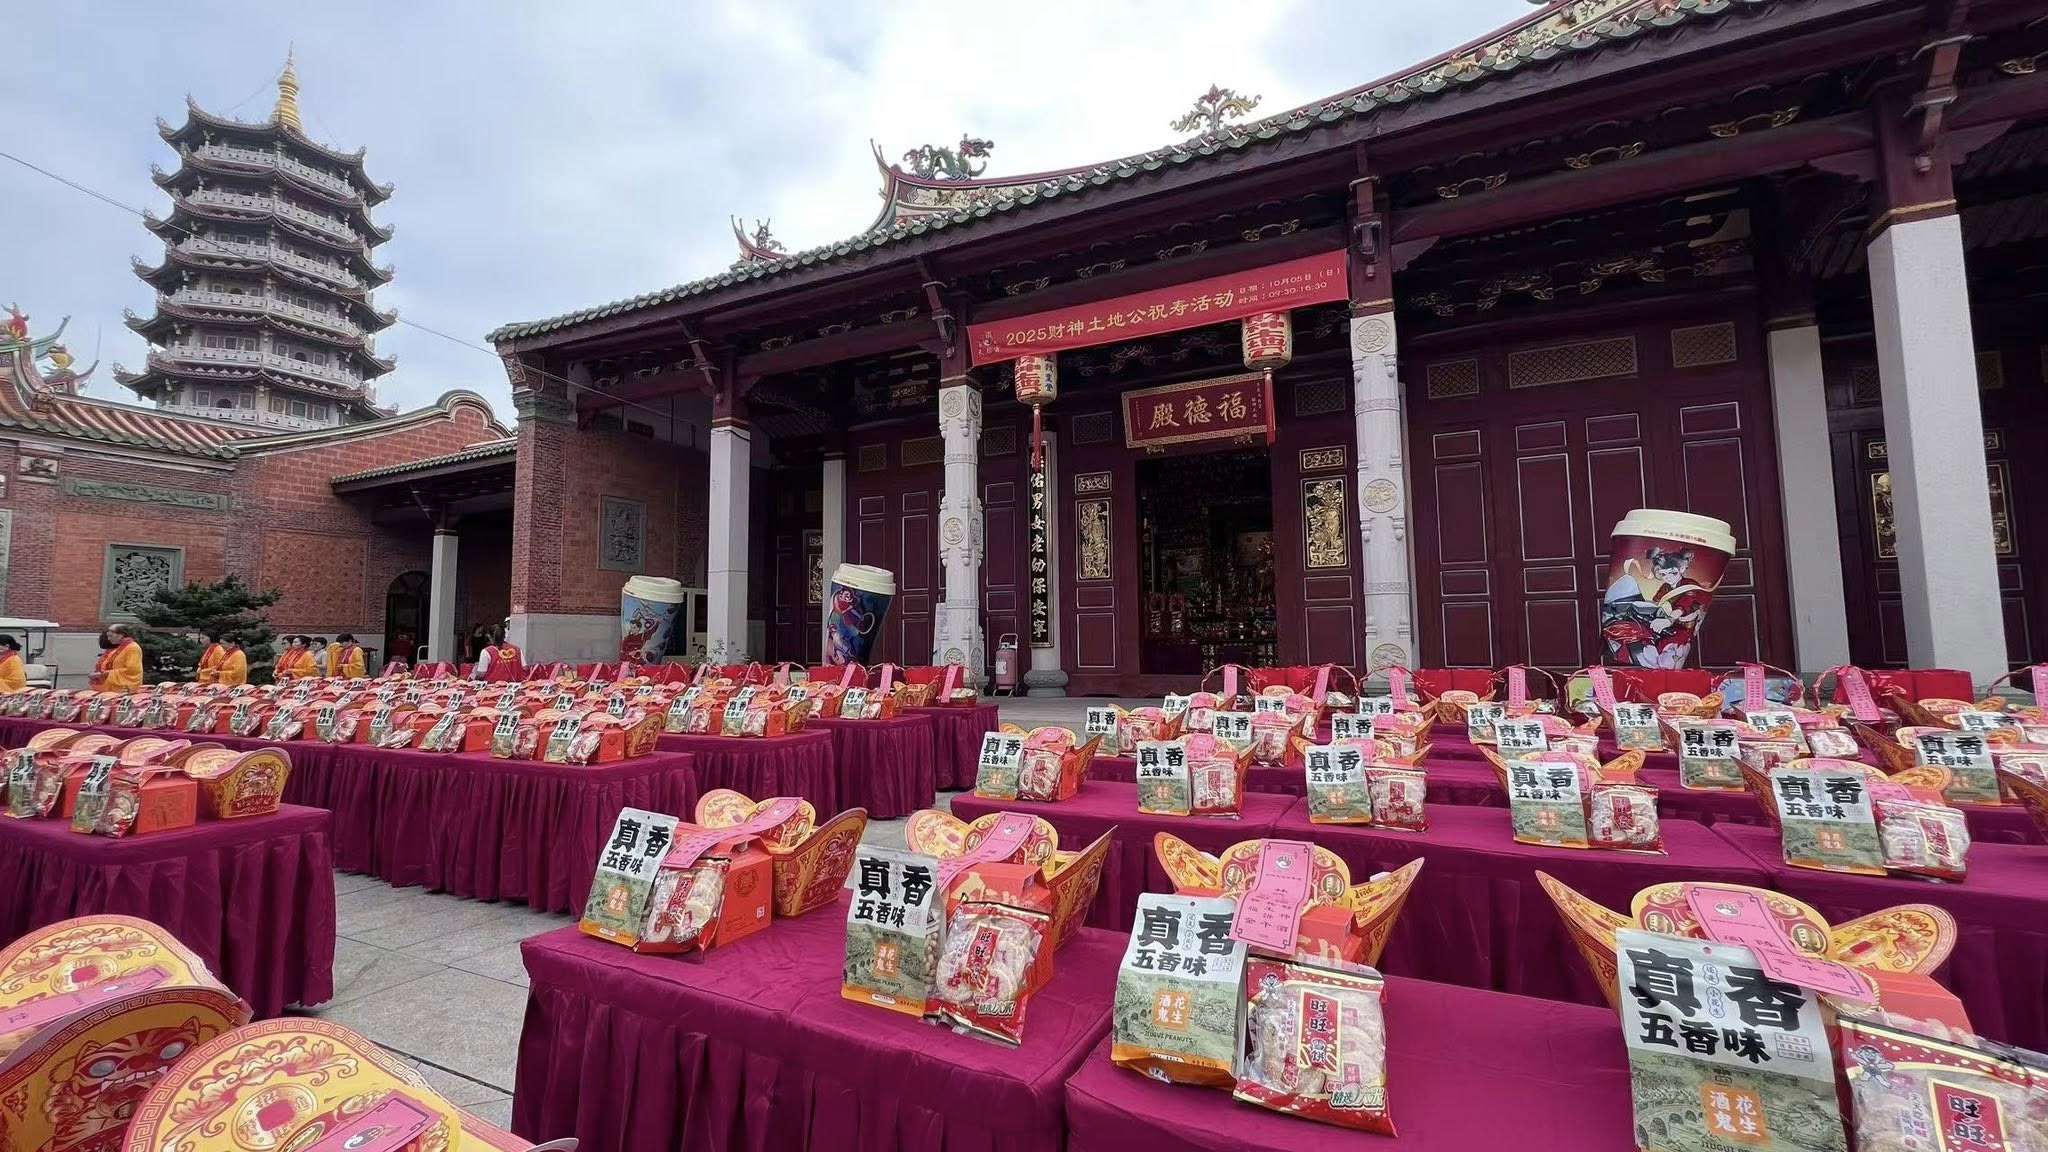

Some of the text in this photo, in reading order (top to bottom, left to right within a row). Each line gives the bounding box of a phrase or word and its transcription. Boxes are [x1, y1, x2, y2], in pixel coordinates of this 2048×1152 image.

[1006, 290, 1234, 346] 2025财神土地公祝寿活动
[1360, 701, 1391, 713] 真香
[1616, 707, 1653, 720] 真香
[1088, 711, 1116, 725] 真香
[1215, 715, 1250, 731] 真香
[1333, 717, 1373, 735] 真香
[1498, 723, 1542, 739] 真香
[1683, 728, 1735, 748] 真香
[984, 737, 1020, 756] 真香
[1500, 737, 1533, 748] 五香味
[1687, 747, 1724, 757] 五香味
[1918, 735, 1983, 756] 真香
[981, 754, 1008, 765] 五香味
[1139, 747, 1184, 767] 真香
[1308, 750, 1361, 772] 真香
[1927, 755, 1973, 766] 五香味
[1140, 767, 1174, 777] 五香味
[1311, 772, 1348, 782] 五香味
[1511, 766, 1574, 789] 真香
[1515, 788, 1562, 800] 五香味
[1776, 775, 1863, 805] 真香
[1785, 802, 1847, 819] 五香味
[612, 818, 670, 859] 真香
[603, 851, 644, 875] 五香味
[859, 857, 933, 907] 真香
[855, 900, 906, 928] 五香味
[1137, 905, 1236, 956] 真香
[1131, 948, 1208, 977] 五香味
[1625, 948, 1807, 1032] 真香
[1638, 1010, 1772, 1064] 五香味
[1947, 1094, 1988, 1146] 旺旺
